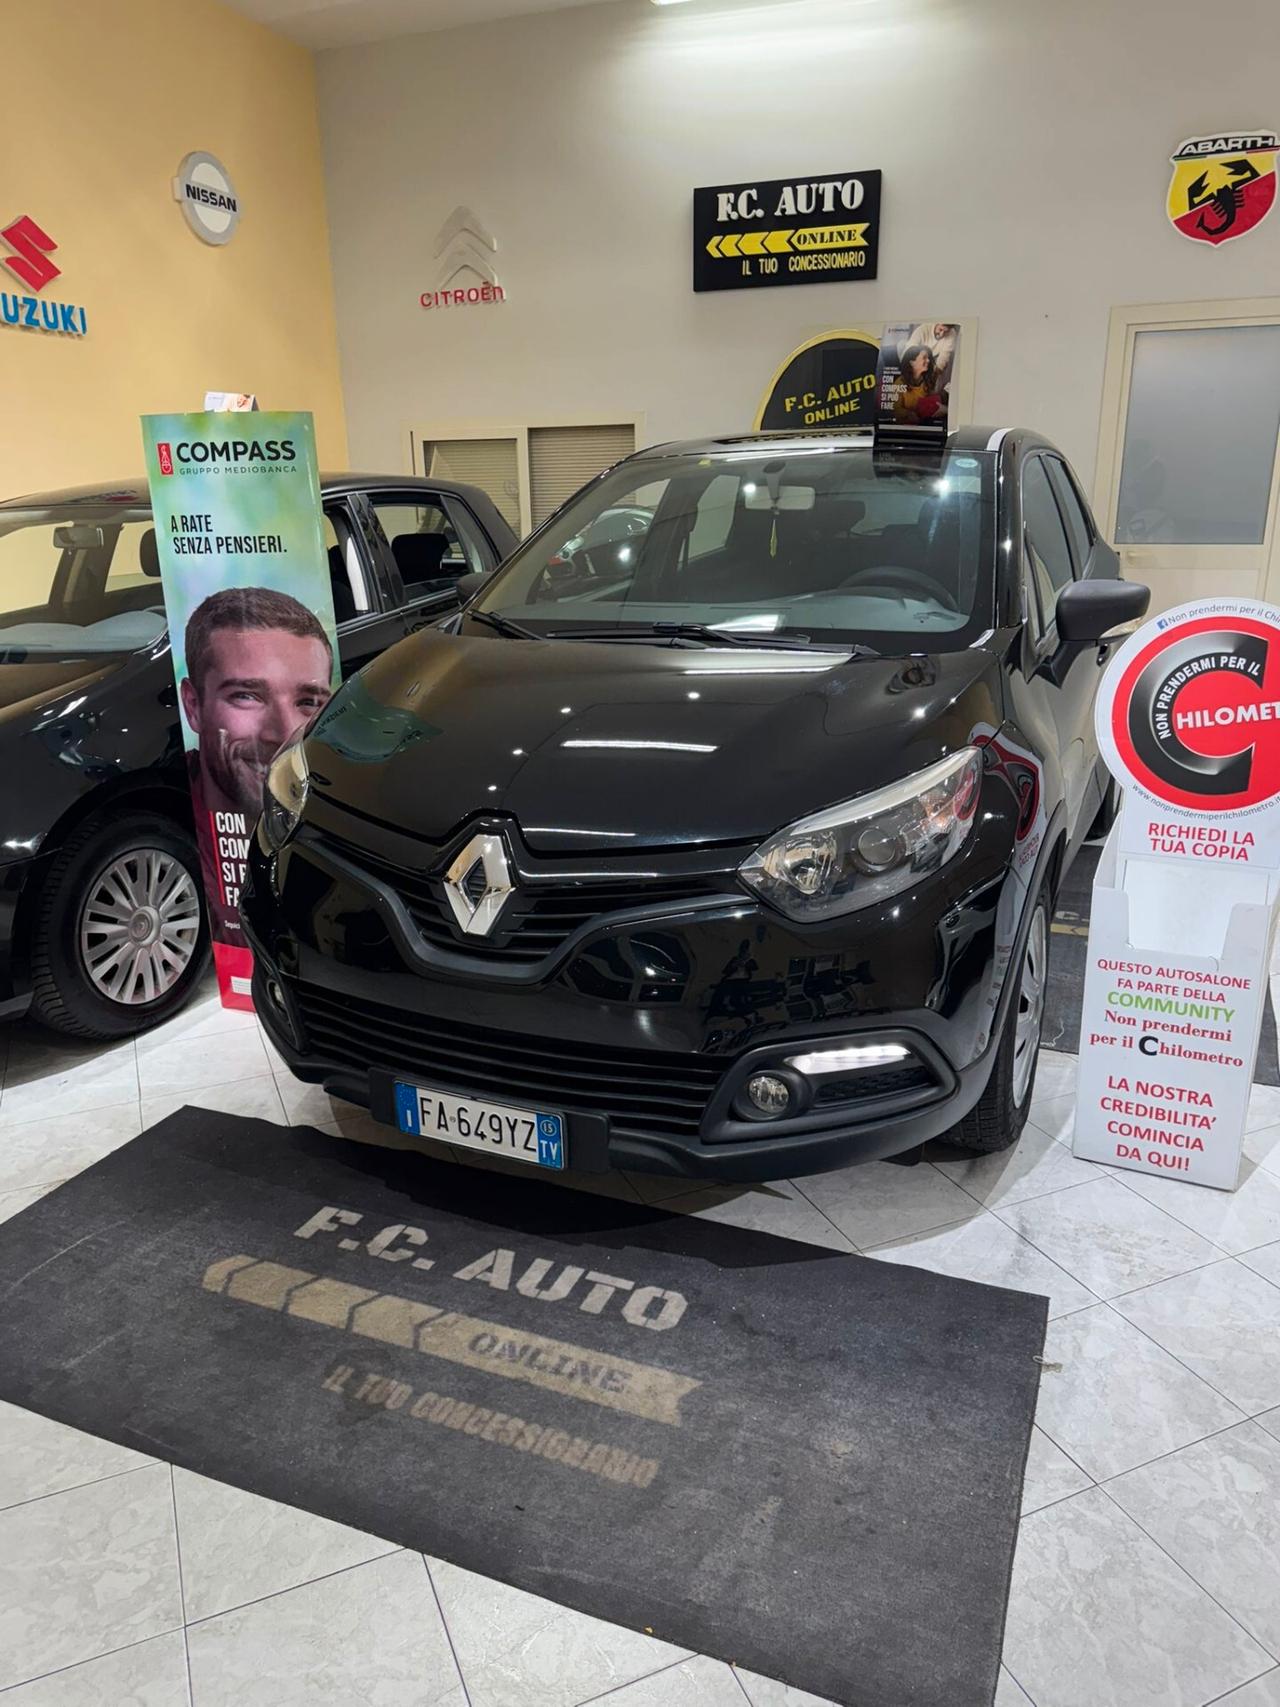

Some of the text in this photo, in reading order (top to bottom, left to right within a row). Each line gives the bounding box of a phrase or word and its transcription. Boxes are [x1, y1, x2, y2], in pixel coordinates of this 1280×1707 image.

[1181, 136, 1273, 155] ABARTH
[186, 183, 237, 212] NISSAN
[716, 178, 865, 222] F.C. AUTO
[797, 229, 857, 246] ONLINE
[742, 250, 866, 276] IL TUO CONCESSIONARIO
[0, 292, 88, 336] UZUKI
[784, 374, 876, 413] F.C. AUTO
[804, 399, 860, 425] ONLINE
[176, 440, 296, 463] COMPASS
[179, 465, 297, 475] GRUPPO MEDIOBANCA
[171, 514, 213, 533] A RATE
[173, 535, 288, 554] SENZA PENSIERI.
[1167, 613, 1187, 625] Non
[1189, 604, 1237, 617] prendermi
[1239, 606, 1256, 616] per
[1257, 608, 1264, 616] il
[1155, 655, 1261, 740] NON PRENDERMI PER IL
[1176, 700, 1280, 730] HILOMET
[215, 811, 247, 835] CON
[1148, 823, 1255, 846] RICHIEDI LA
[219, 837, 250, 861] COM
[1150, 838, 1249, 861] TUA COPIA
[222, 861, 236, 884] SI
[1097, 958, 1251, 990] QUESTO AUTOSALONE
[1117, 978, 1226, 1004] FA PARTE DELLA
[1107, 991, 1236, 1024] COMMUNITY
[1104, 1010, 1232, 1042] Non prendermi
[1090, 1031, 1244, 1067] per il Chilometro
[1107, 1075, 1214, 1107] LA NOSTRA
[1107, 1120, 1205, 1152] COMINCIA
[539, 1139, 558, 1161] TV
[1116, 1144, 1190, 1171] DA QUI!
[294, 1206, 689, 1332] F.C. AUTO
[467, 1332, 633, 1394] ONLINE
[322, 1365, 353, 1393] IL
